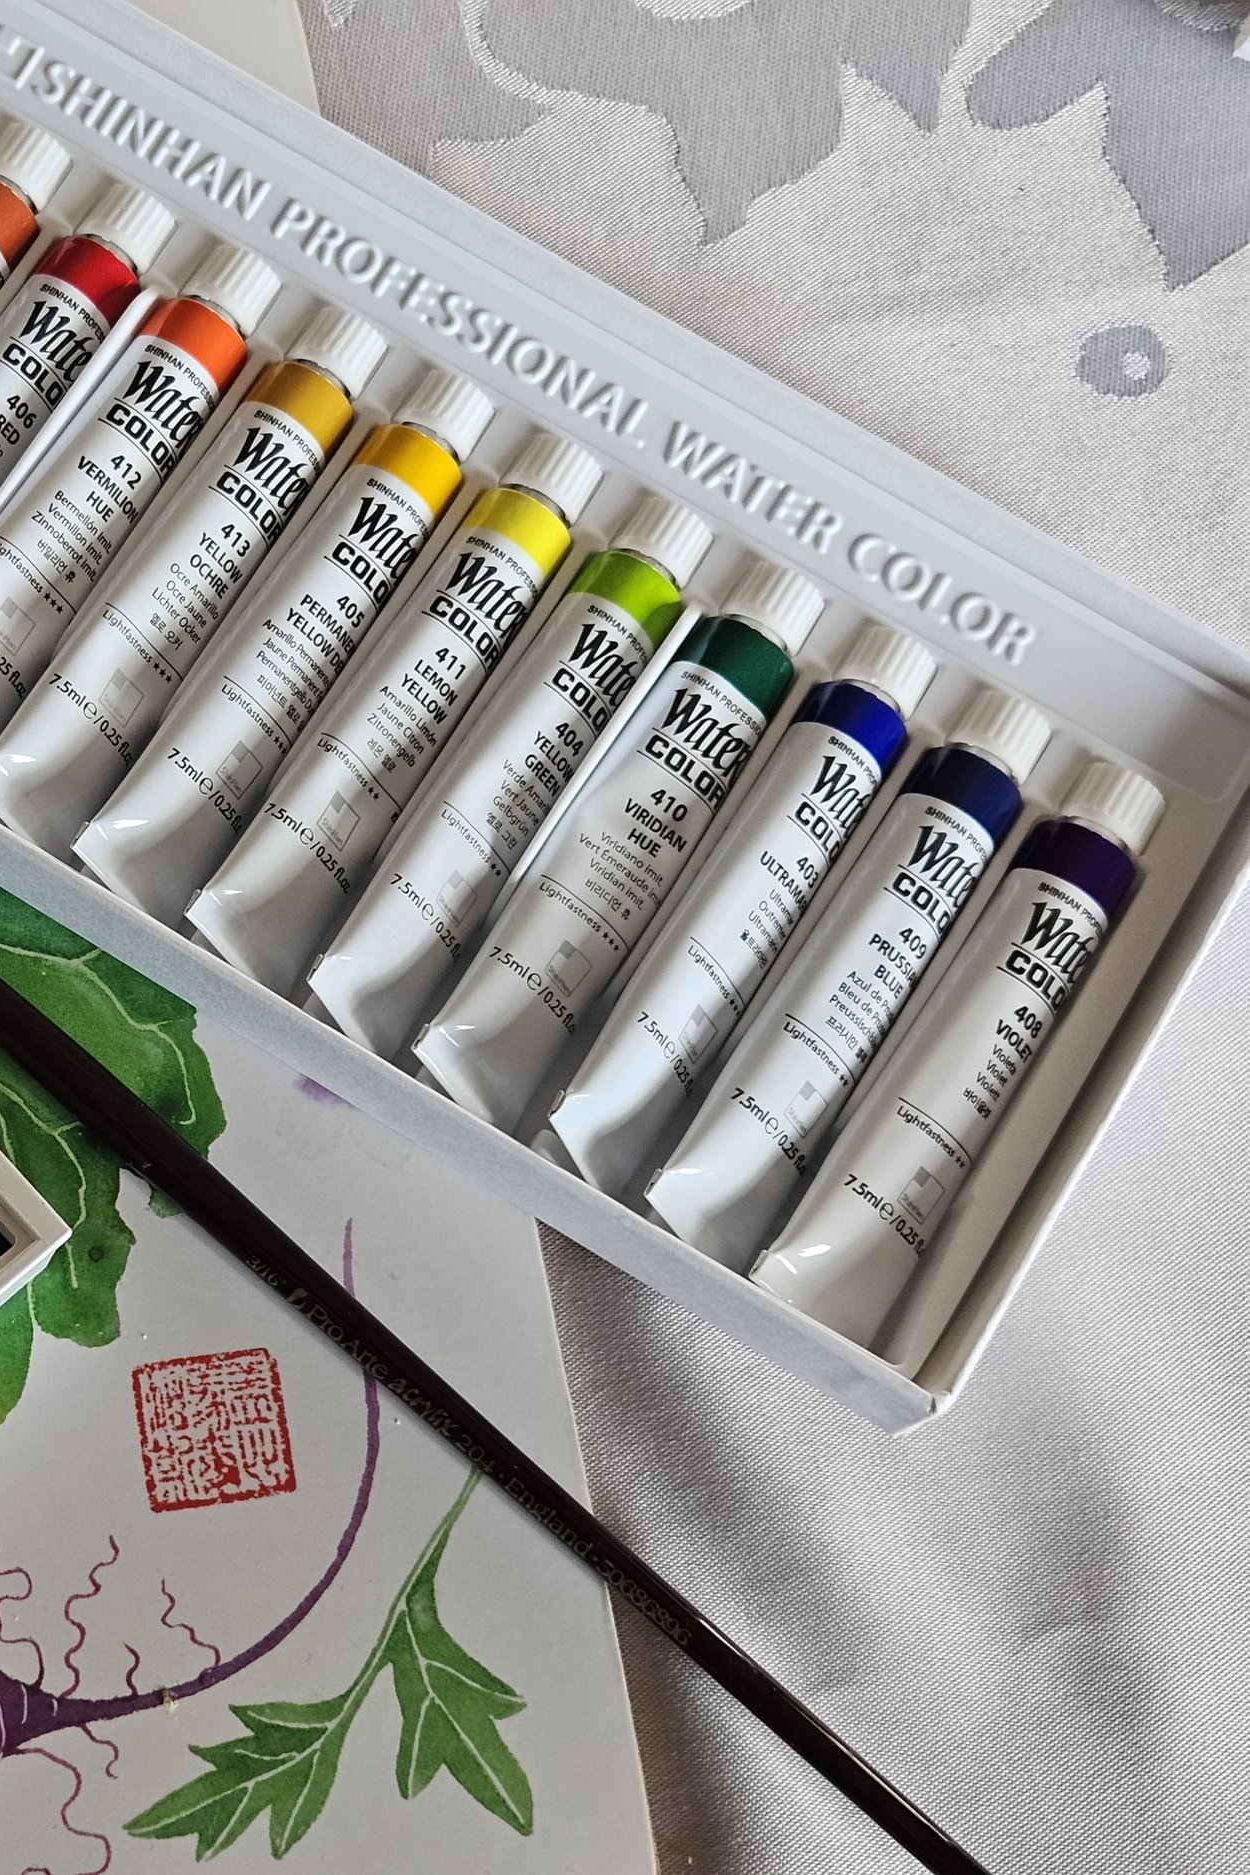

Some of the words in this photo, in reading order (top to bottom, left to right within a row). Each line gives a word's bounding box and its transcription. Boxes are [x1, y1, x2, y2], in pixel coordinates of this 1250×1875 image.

[39, 283, 80, 312] SHINHAN
[32, 58, 271, 221] SHINHAN
[270, 198, 650, 449] PROFESSIONAL
[662, 418, 843, 555] WATER
[847, 532, 1037, 667] COLOR
[144, 343, 185, 372] SHINHAN
[6, 394, 38, 430] 406
[253, 409, 293, 438] SHINHAN
[76, 454, 140, 525] VERMILION
[110, 454, 143, 491] 412
[85, 490, 115, 523] HUE
[366, 477, 406, 509] SHINHAN
[48, 503, 88, 547] Vermillon
[54, 490, 99, 537] Bermellón
[31, 510, 82, 565] Zinnoberrot
[220, 523, 252, 558] 413
[466, 536, 507, 561] SHINHAN
[188, 553, 230, 600] OCHRE
[198, 531, 244, 584] YELLOW
[165, 579, 186, 604] Ocre
[183, 599, 208, 630] Jaune
[168, 562, 192, 588] Ocre
[188, 583, 220, 621] Amarillo
[151, 586, 180, 620] Lichter
[177, 616, 202, 645] Ocker
[336, 594, 366, 629] 405
[587, 604, 627, 635] SHINHAN
[102, 608, 153, 664] Lightfastness
[262, 619, 298, 650] Amarillo
[263, 637, 288, 662] Jaune
[285, 607, 334, 662] YELLOW
[413, 659, 459, 707] LEMON
[435, 647, 467, 680] 411
[400, 673, 448, 725] YELLOW
[680, 670, 721, 698] SHINHAN
[220, 683, 274, 738] Lightfastness
[376, 702, 404, 731] Jaune
[402, 727, 425, 754] Citron
[379, 685, 417, 722] Amarillo
[415, 719, 437, 748] Limón
[367, 712, 416, 768] Zitronengelb
[533, 730, 575, 781] YELLOW
[555, 722, 584, 757] 404
[828, 735, 865, 769] SHINHAN
[317, 737, 368, 788] Lightfastness
[502, 759, 526, 789] Verde
[524, 753, 561, 797] GREEN
[492, 795, 530, 837] Gelbgrün
[500, 779, 517, 802] Vert
[515, 799, 540, 826] Jaune
[650, 789, 688, 822] 410
[924, 805, 967, 836] SHINHAN
[440, 808, 492, 864] Lightfastness
[623, 798, 688, 853] VIRIDIAN
[627, 828, 662, 858] HUE
[579, 833, 600, 854] Vert
[601, 849, 649, 893] Émeraude
[601, 831, 644, 870] Viridiano
[589, 857, 626, 893] Viridian
[796, 856, 820, 889] 403
[538, 881, 602, 933] Lightfastness
[1037, 881, 1082, 911] SHINHAN
[898, 926, 928, 960] 409
[687, 945, 730, 1000] Lightfastness
[846, 970, 871, 993] Azul
[870, 987, 884, 1004] de
[873, 964, 904, 1000] BLUE
[838, 981, 861, 1004] Bleu
[860, 1001, 874, 1017] de
[995, 1019, 1033, 1064] VIOLET
[1013, 1005, 1043, 1040] 408
[783, 1021, 840, 1076] Lightfastness
[992, 1043, 1018, 1076] Violeta
[975, 1072, 1001, 1102] Violett
[986, 1059, 1009, 1088] Violet
[896, 1105, 956, 1158] Lightfastness
[505, 1476, 595, 1558] England
